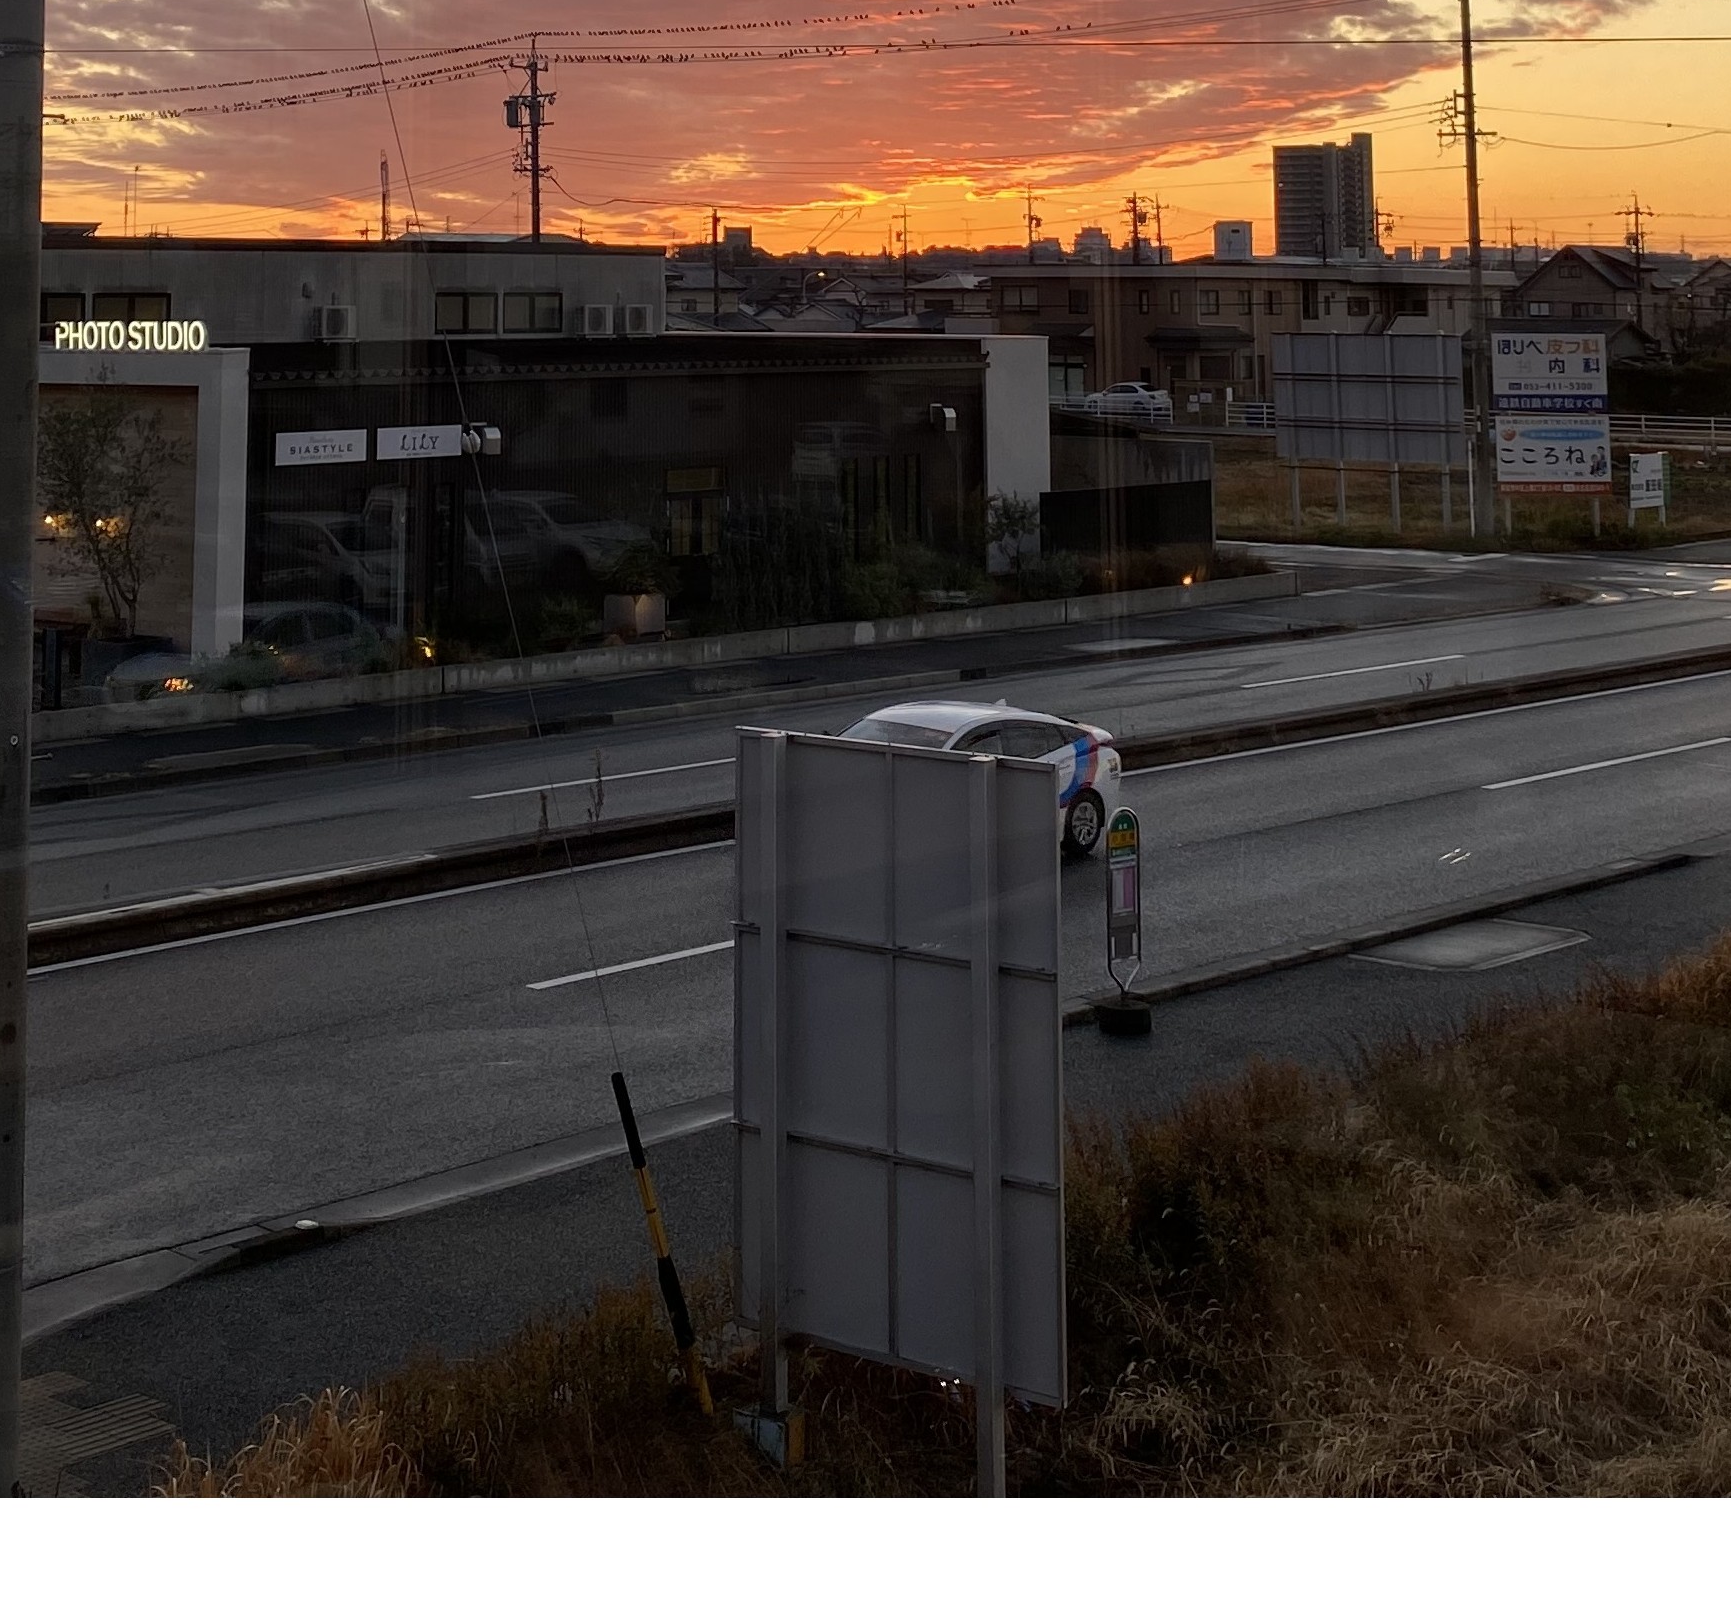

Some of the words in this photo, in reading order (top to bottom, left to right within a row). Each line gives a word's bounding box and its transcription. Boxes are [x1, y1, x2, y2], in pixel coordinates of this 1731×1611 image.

[55, 320, 126, 350] PHOTO
[128, 320, 206, 351] STUDIO
[289, 443, 354, 455] SIASTYLE
[400, 433, 440, 451] LILY
[1501, 446, 1586, 465] こころね
